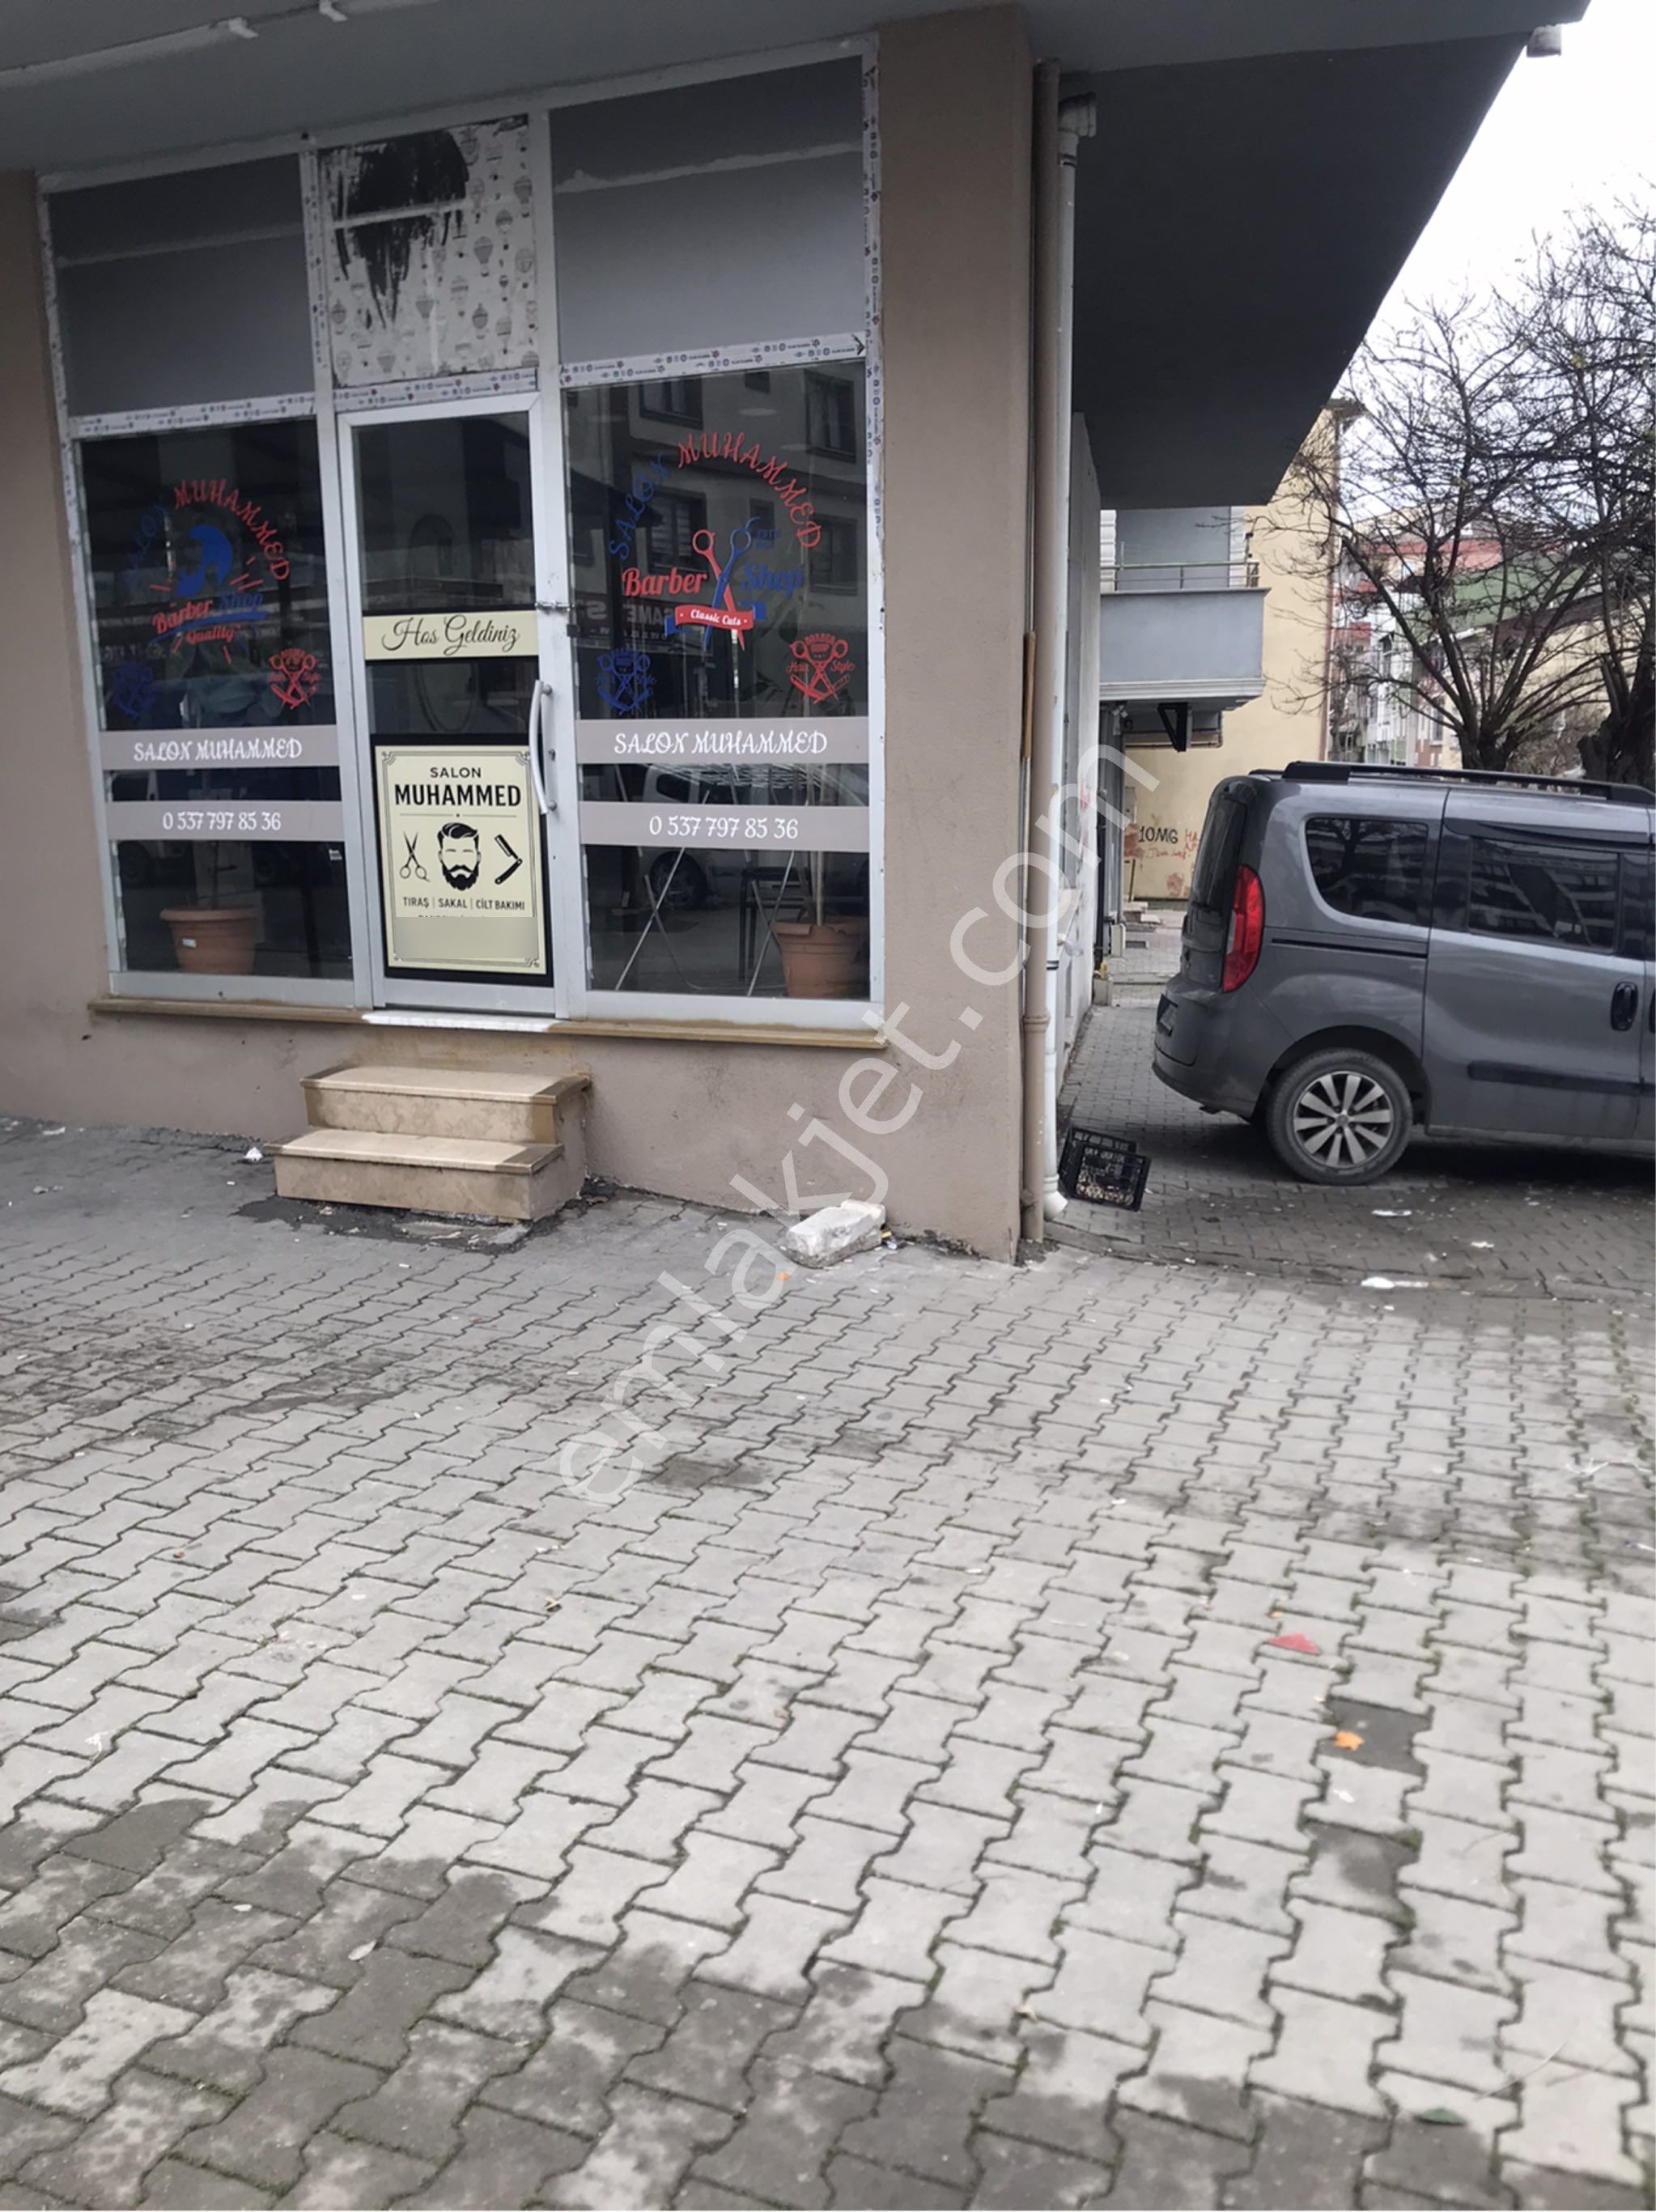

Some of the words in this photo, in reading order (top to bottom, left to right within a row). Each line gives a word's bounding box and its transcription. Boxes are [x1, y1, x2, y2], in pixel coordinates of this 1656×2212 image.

[609, 452, 670, 561] SALON
[677, 431, 822, 549] MUHAMMED
[173, 478, 291, 581] MUHAMMED
[621, 567, 708, 597] Barber
[740, 564, 804, 601] Shop
[151, 599, 214, 635] Barber
[219, 591, 265, 613] Shop
[690, 608, 721, 624] Classic
[721, 614, 741, 626] Cuts
[185, 626, 236, 643] Quality
[443, 614, 520, 656] Geldiniz
[133, 741, 193, 762] SALON
[194, 736, 304, 762] MUHAMMED
[613, 732, 689, 754] SALON
[690, 729, 828, 755] MUHAMMED
[430, 766, 482, 779] SALON
[394, 783, 522, 807] MUHAMMED
[163, 812, 173, 830] 0
[176, 811, 204, 830] 537
[206, 811, 235, 830] 797
[238, 812, 257, 830] 85
[261, 812, 282, 830] 36
[648, 815, 662, 835] 0
[666, 815, 702, 836] 537
[705, 816, 740, 837] 797
[744, 817, 768, 839] 85
[773, 817, 799, 839] 36
[402, 896, 430, 908] TIRAŞ
[438, 898, 468, 908] SAKAL
[476, 897, 493, 910] CİLT
[495, 899, 525, 911] BAKIMI
